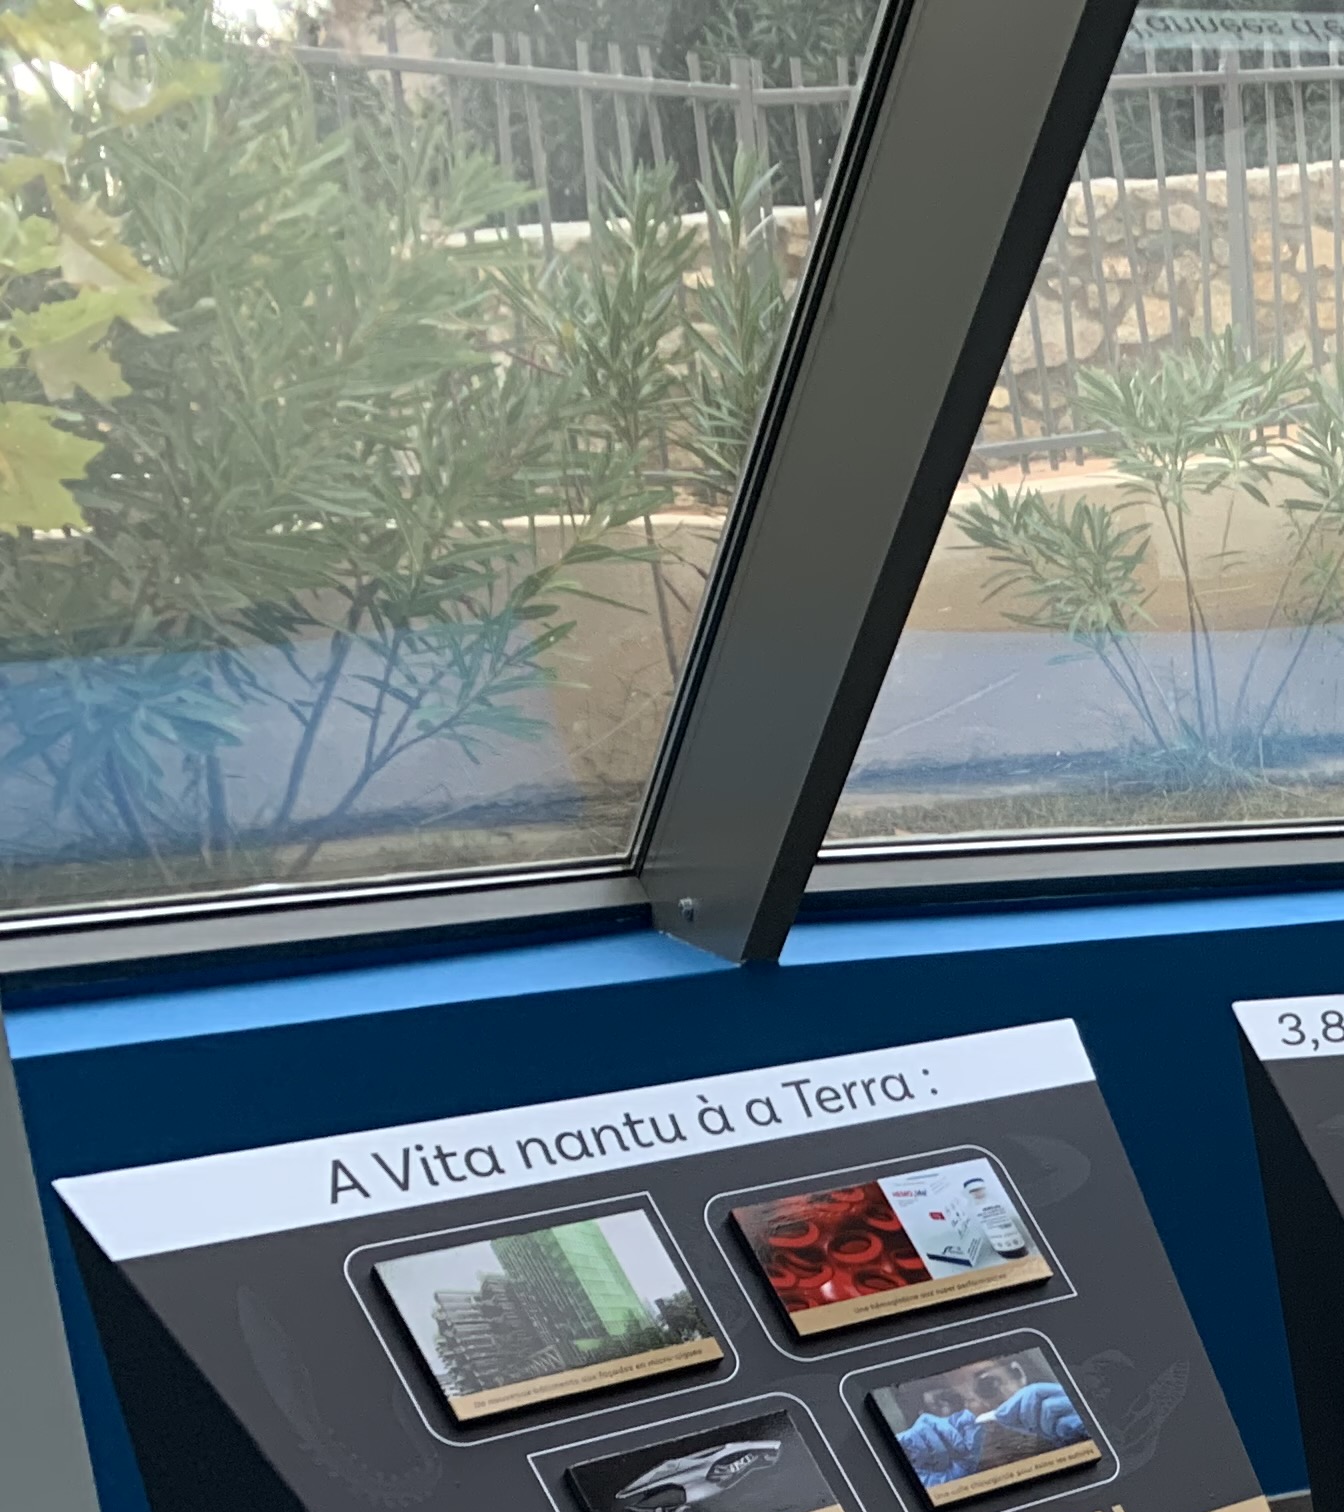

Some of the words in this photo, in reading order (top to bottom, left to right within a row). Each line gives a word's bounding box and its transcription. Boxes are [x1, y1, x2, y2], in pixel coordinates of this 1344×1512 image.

[330, 1159, 371, 1205] A
[371, 1144, 506, 1192] Vita
[516, 1112, 688, 1170] nantu
[697, 1094, 735, 1135] à
[745, 1096, 783, 1127] a
[782, 1073, 915, 1118] Terra
